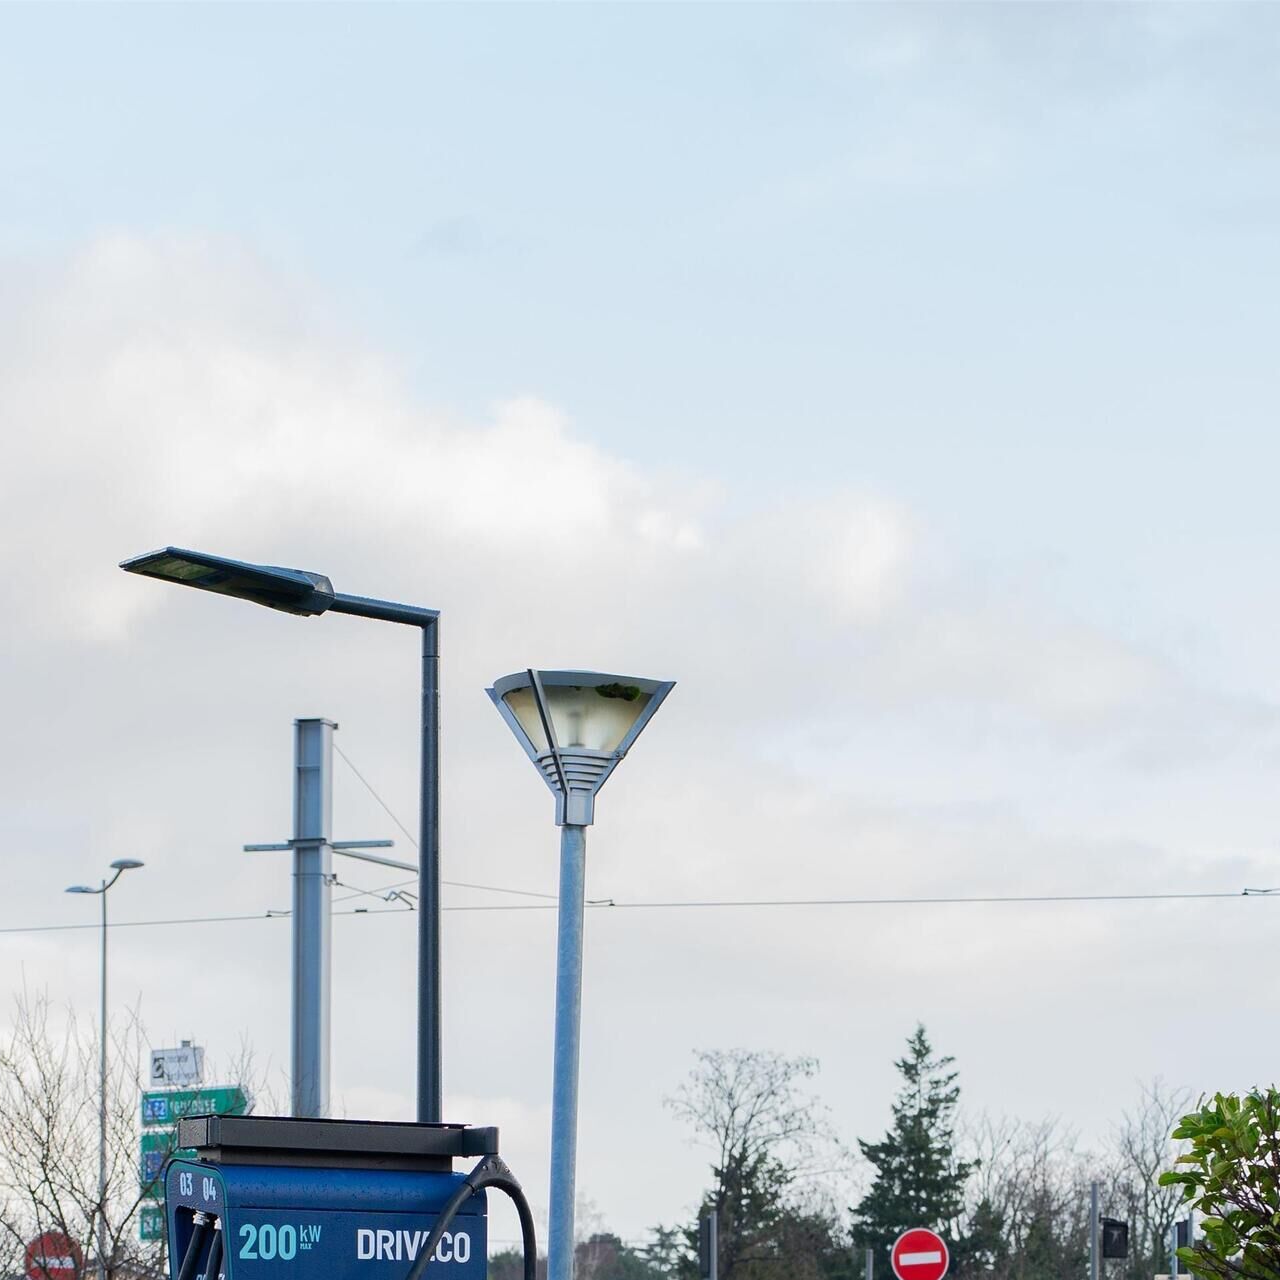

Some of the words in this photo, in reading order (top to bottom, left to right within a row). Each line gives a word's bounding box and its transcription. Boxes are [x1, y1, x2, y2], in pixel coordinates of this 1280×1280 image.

[180, 1172, 193, 1196] 03
[202, 1177, 216, 1201] 04
[239, 1223, 297, 1260] 200
[300, 1225, 321, 1243] kW
[358, 1228, 470, 1263] DRIVCO
